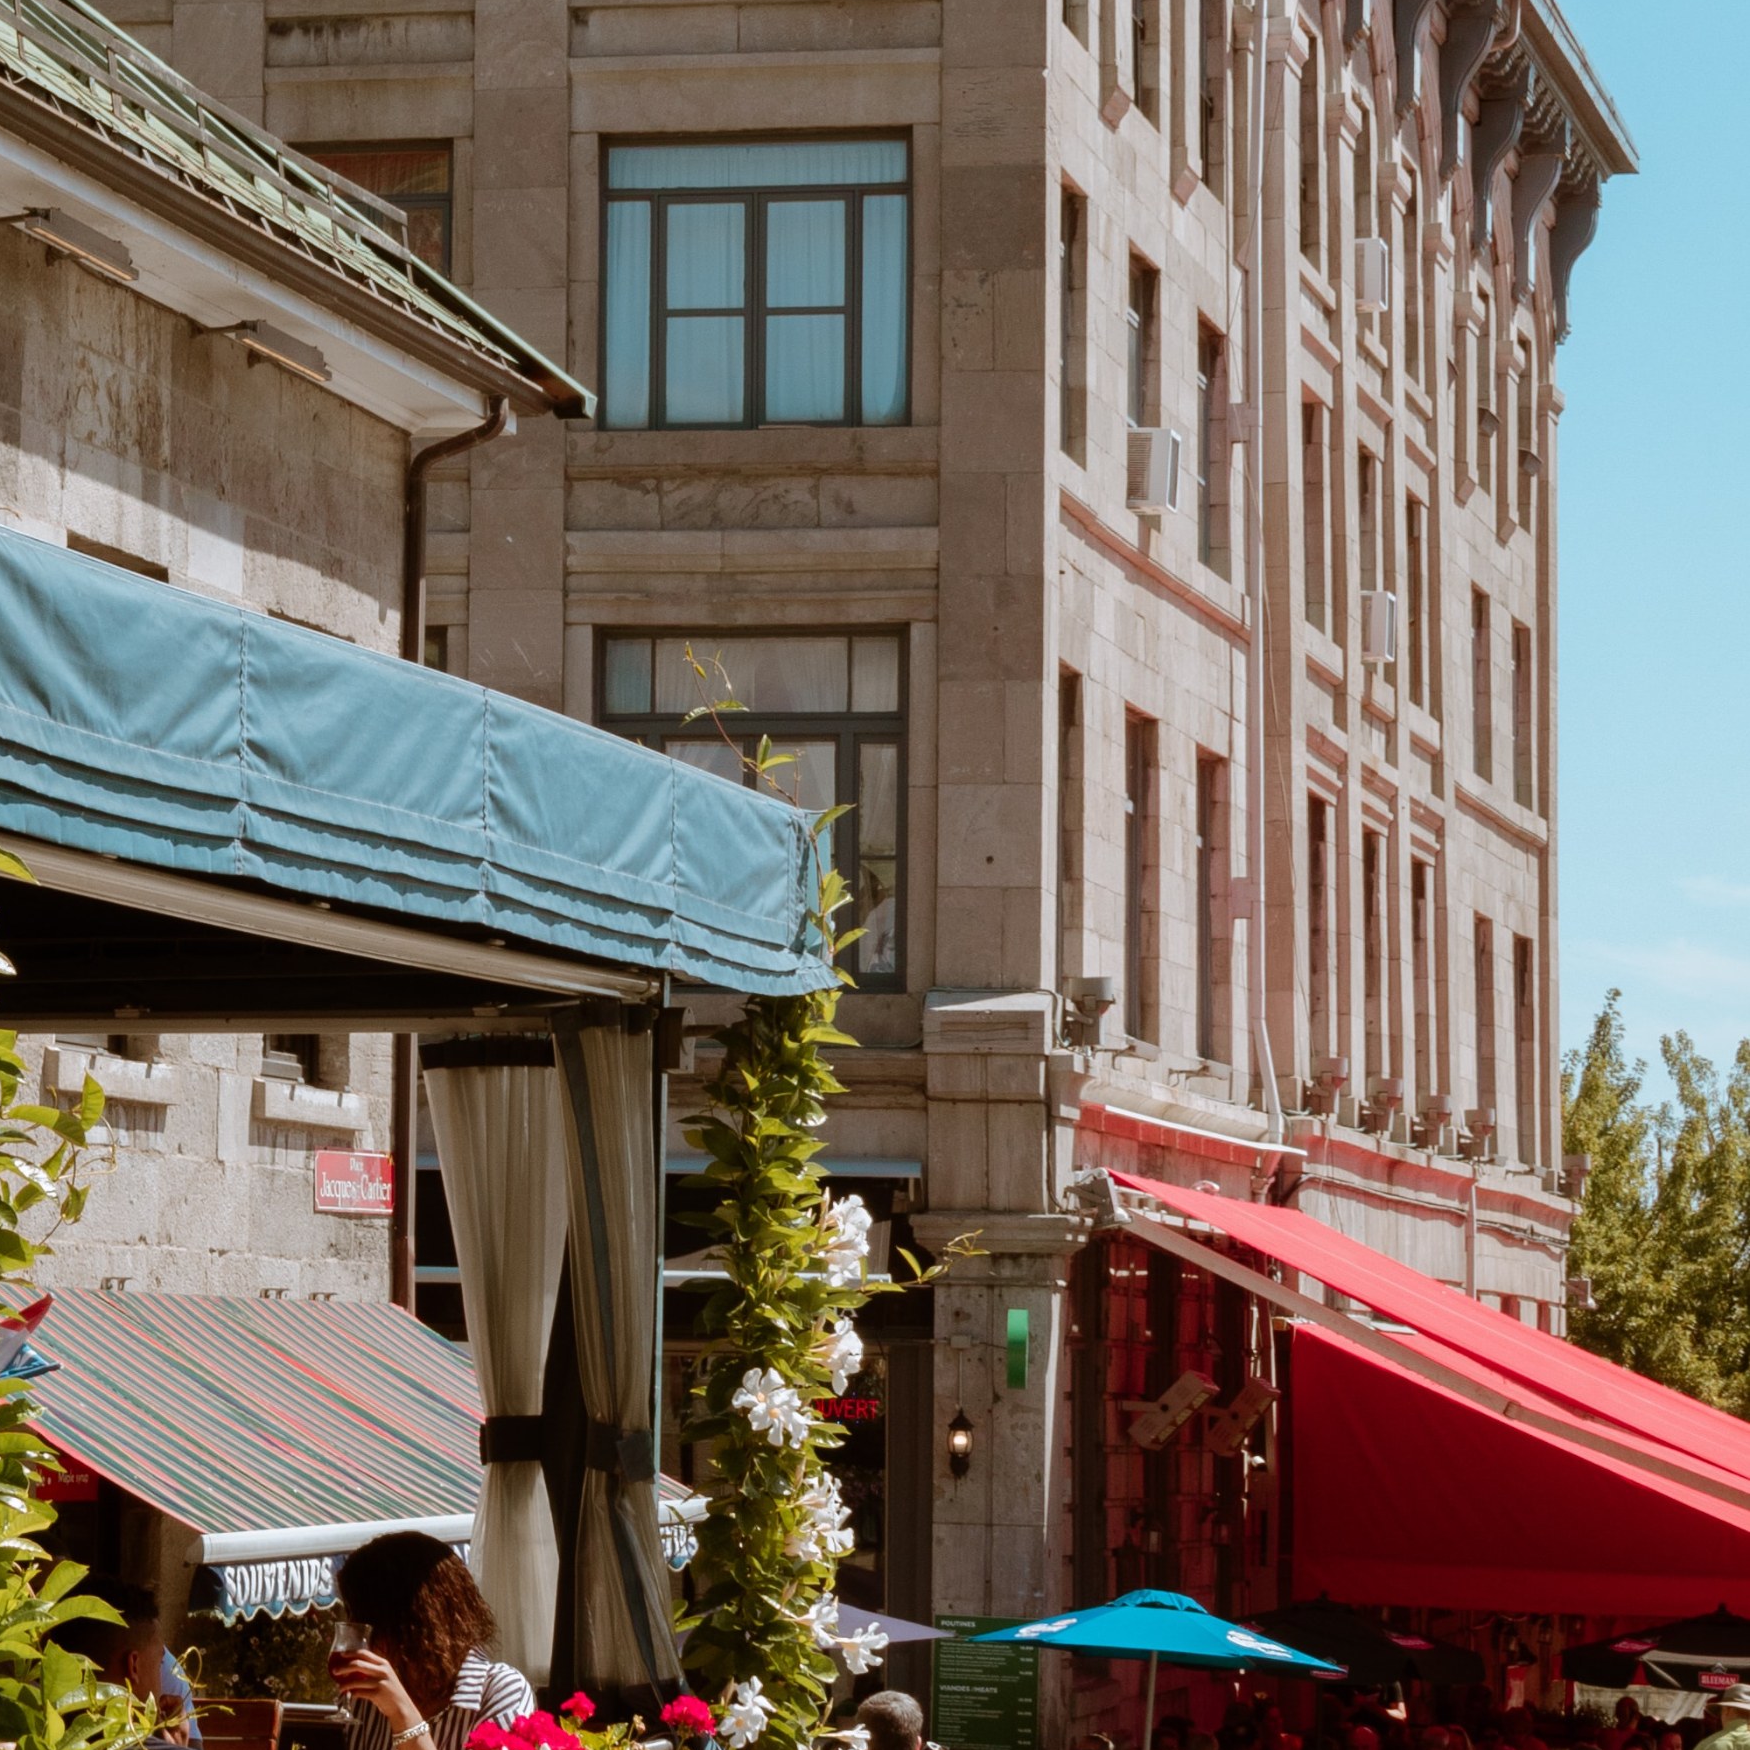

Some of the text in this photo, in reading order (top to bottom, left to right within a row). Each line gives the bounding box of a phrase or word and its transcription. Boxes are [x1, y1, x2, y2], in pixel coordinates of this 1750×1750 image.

[320, 1171, 392, 1207] Jacques-Cartier
[223, 1556, 333, 1606] SOUVENIRS
[940, 1620, 976, 1628] POUTINES
[939, 1684, 970, 1692] VIANDES
